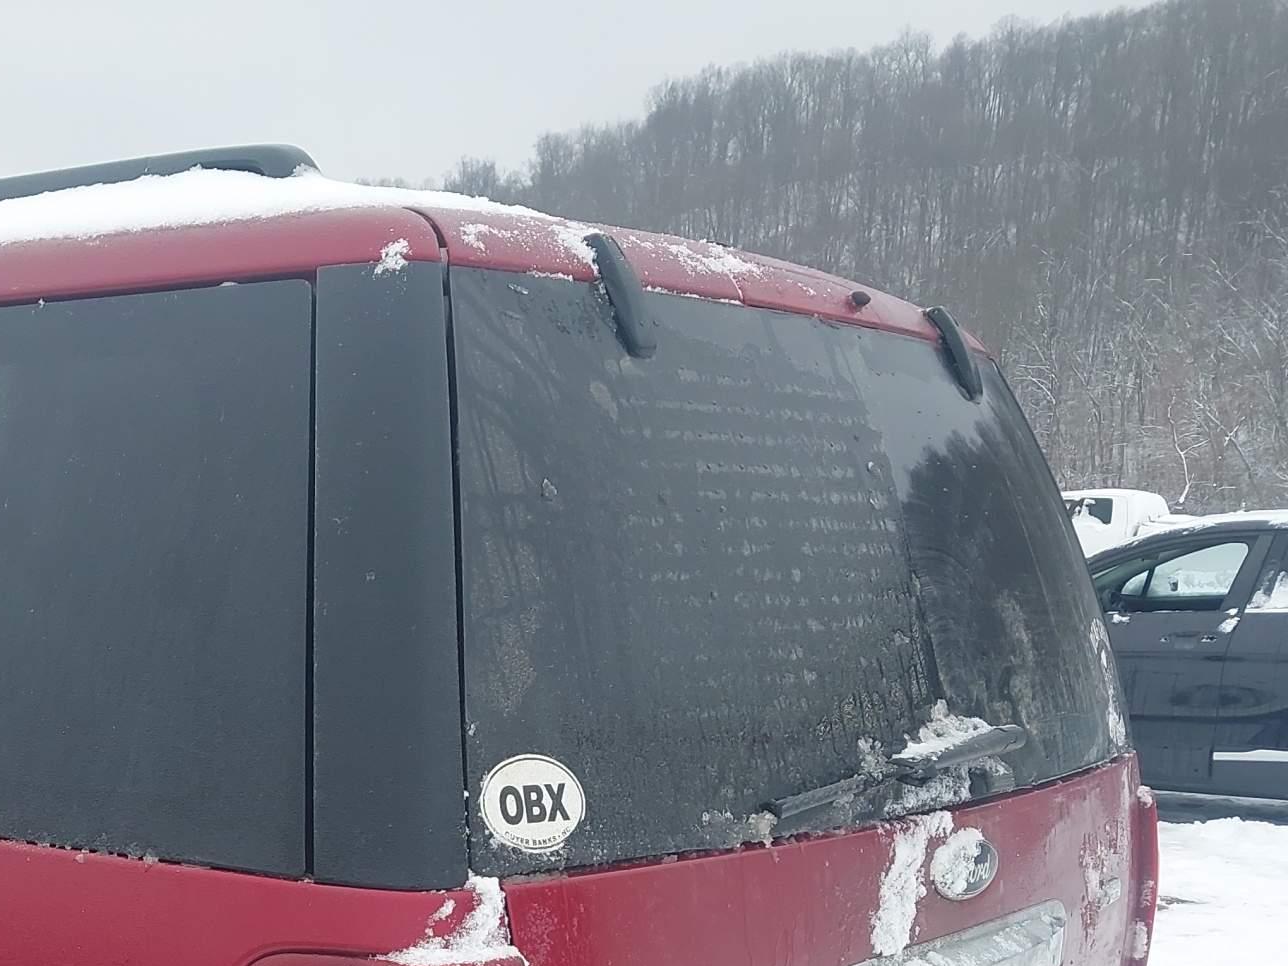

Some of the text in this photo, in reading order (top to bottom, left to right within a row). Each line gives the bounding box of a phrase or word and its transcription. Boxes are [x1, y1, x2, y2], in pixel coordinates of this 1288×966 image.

[499, 783, 570, 825] OBX
[504, 826, 571, 846] OUTER BANKS NC
